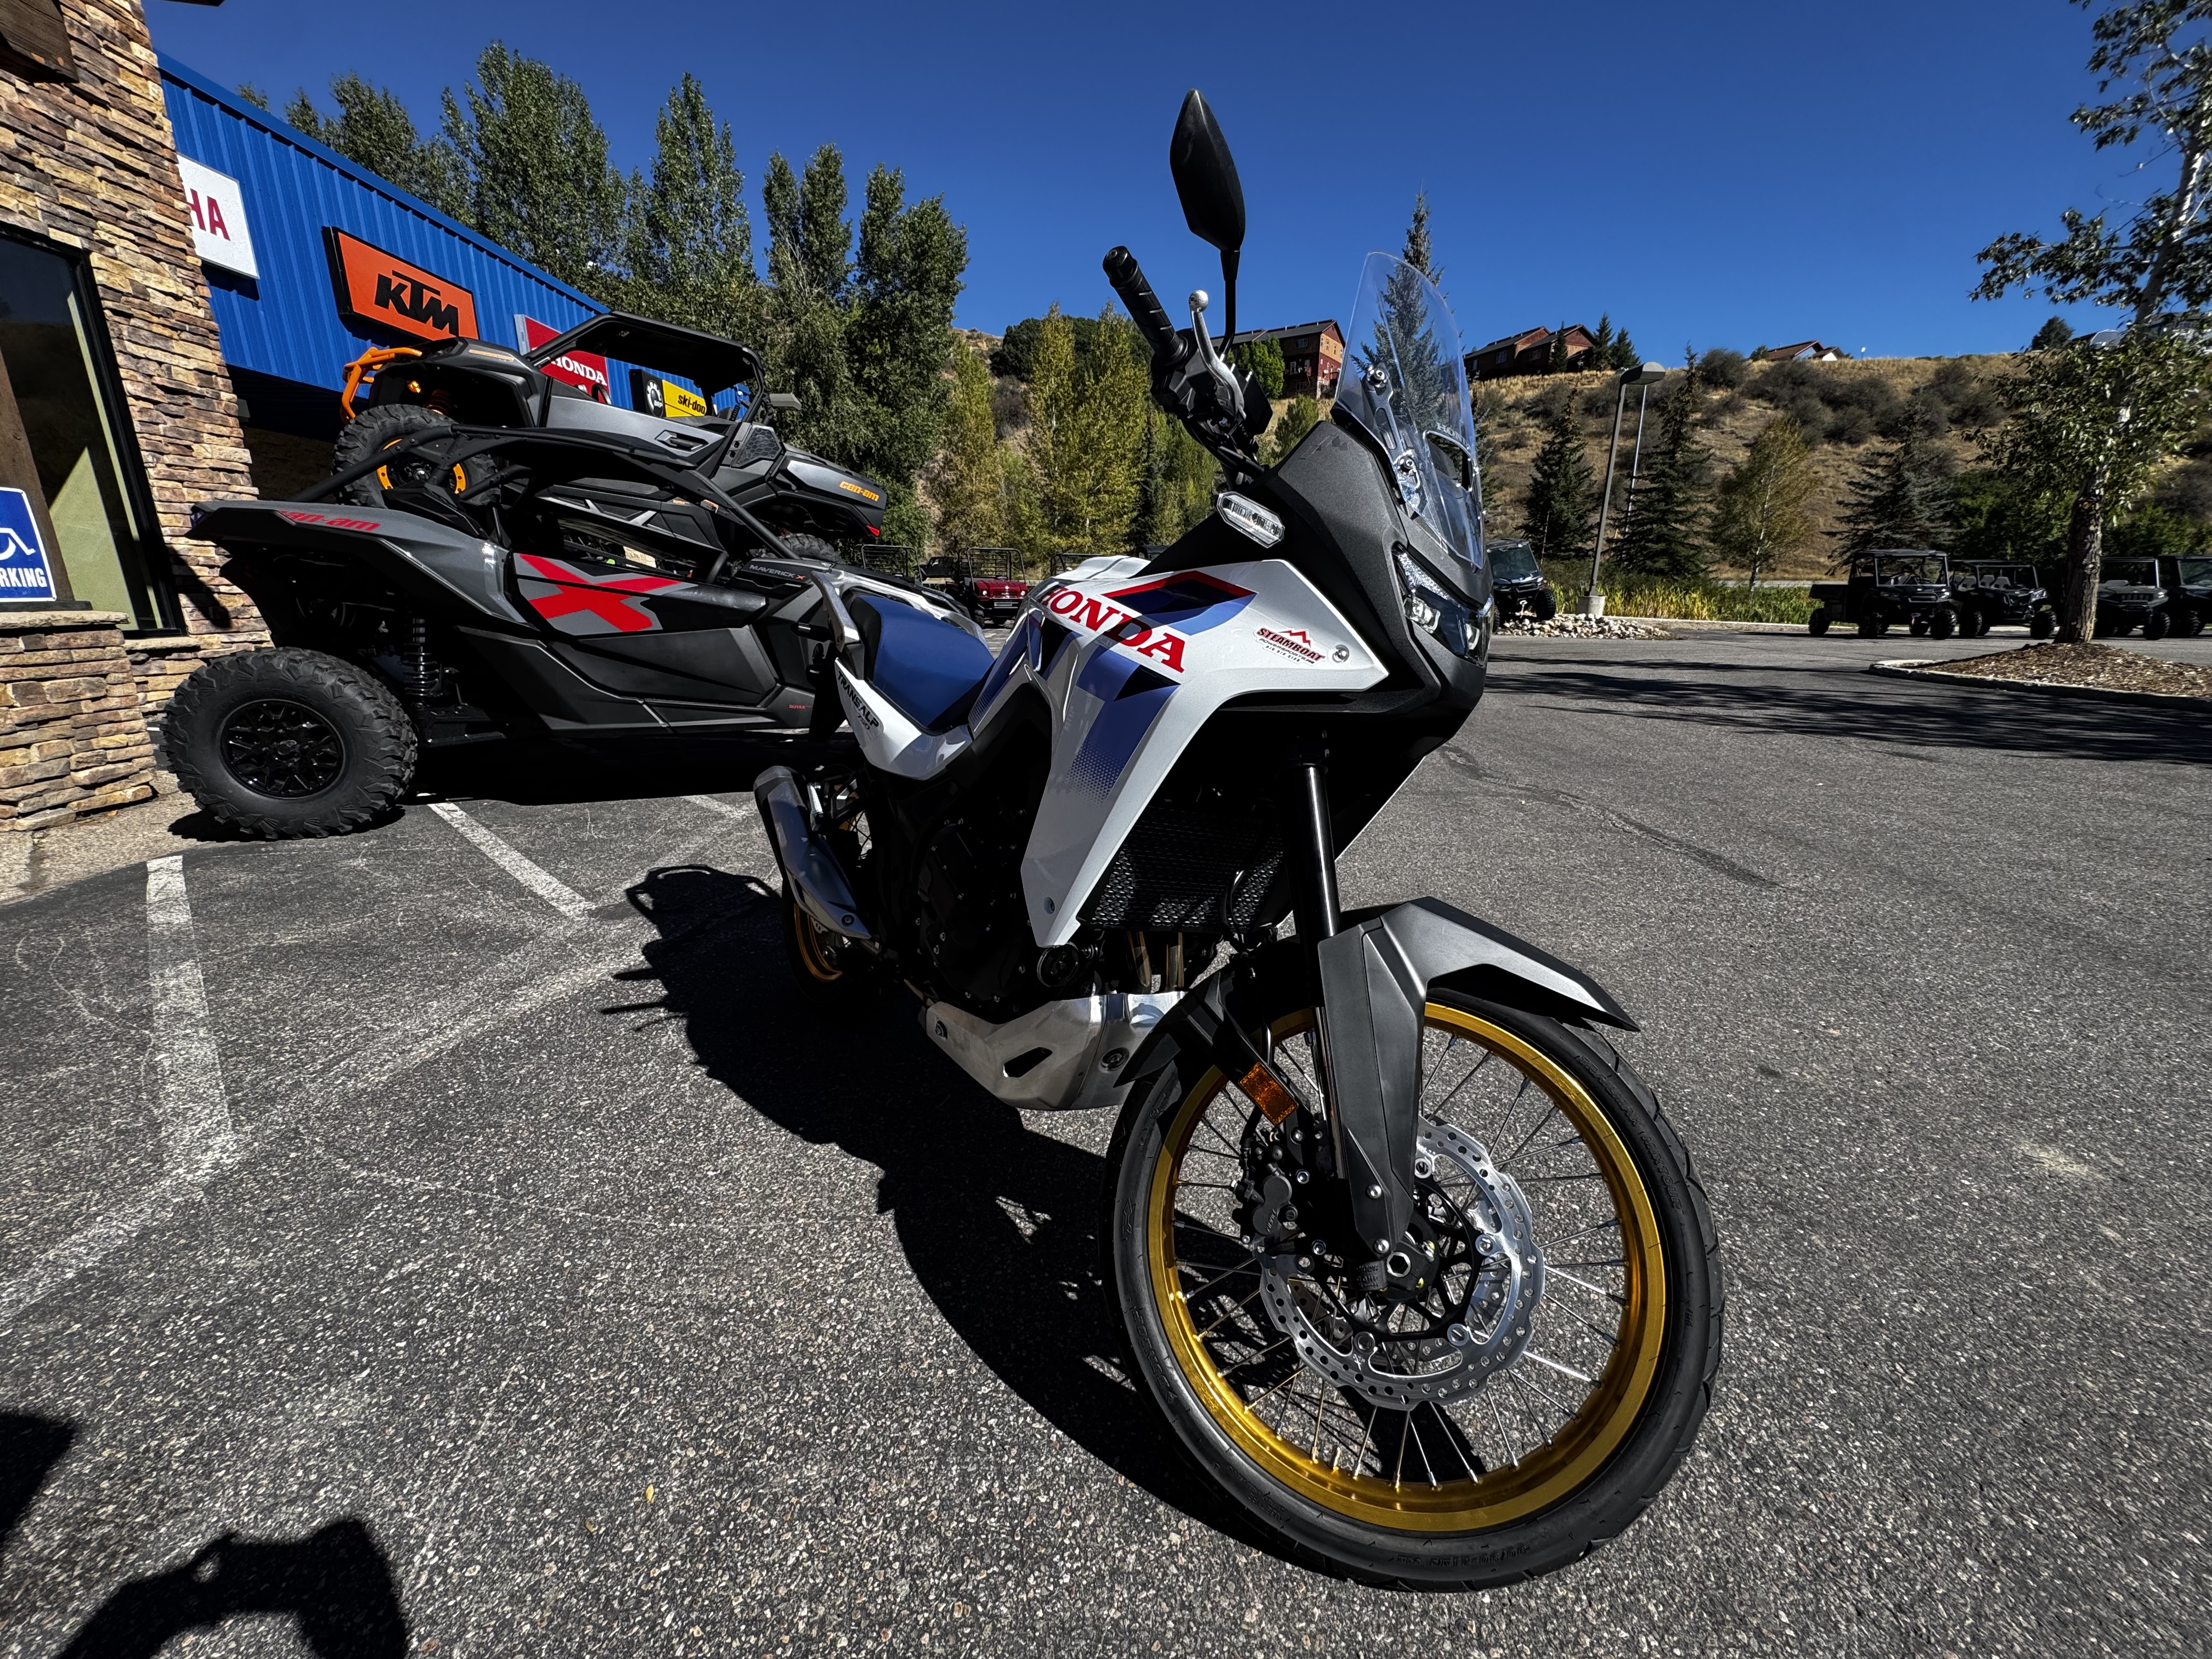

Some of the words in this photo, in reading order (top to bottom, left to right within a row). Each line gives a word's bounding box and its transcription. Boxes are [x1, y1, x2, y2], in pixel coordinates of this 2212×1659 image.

[375, 270, 459, 337] KTM
[678, 394, 706, 414] ski-doo
[839, 481, 879, 501] can-am
[749, 565, 795, 578] MAVERICK
[1037, 585, 1185, 674] HONDA
[1256, 627, 1326, 662] STEAMBOAT
[838, 670, 880, 728] TRANSALP
